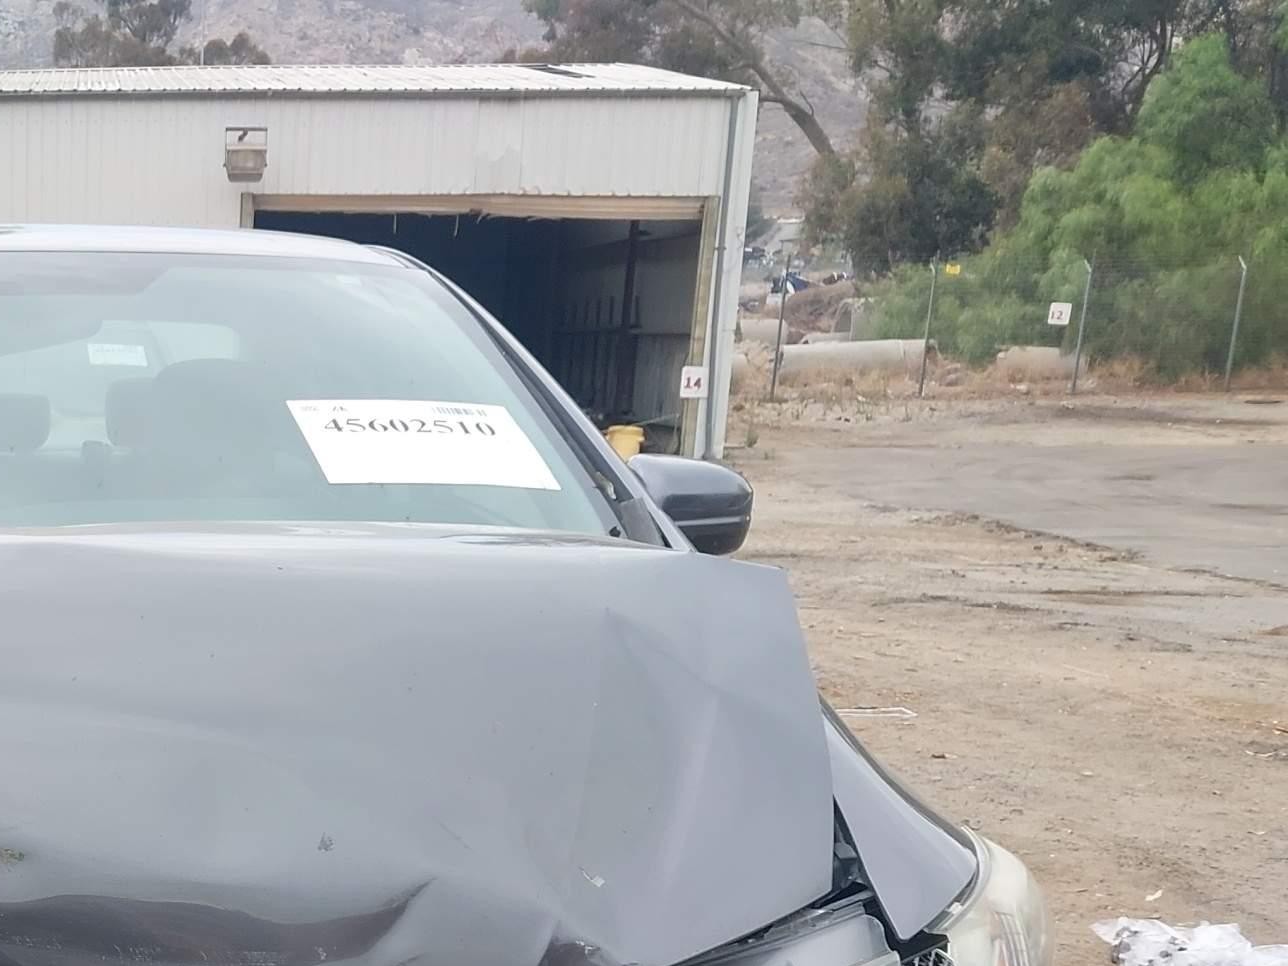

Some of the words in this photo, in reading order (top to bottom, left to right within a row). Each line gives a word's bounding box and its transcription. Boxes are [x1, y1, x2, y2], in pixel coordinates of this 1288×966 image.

[1051, 310, 1063, 320] 12
[683, 376, 702, 389] 14
[323, 418, 496, 436] 45602510
